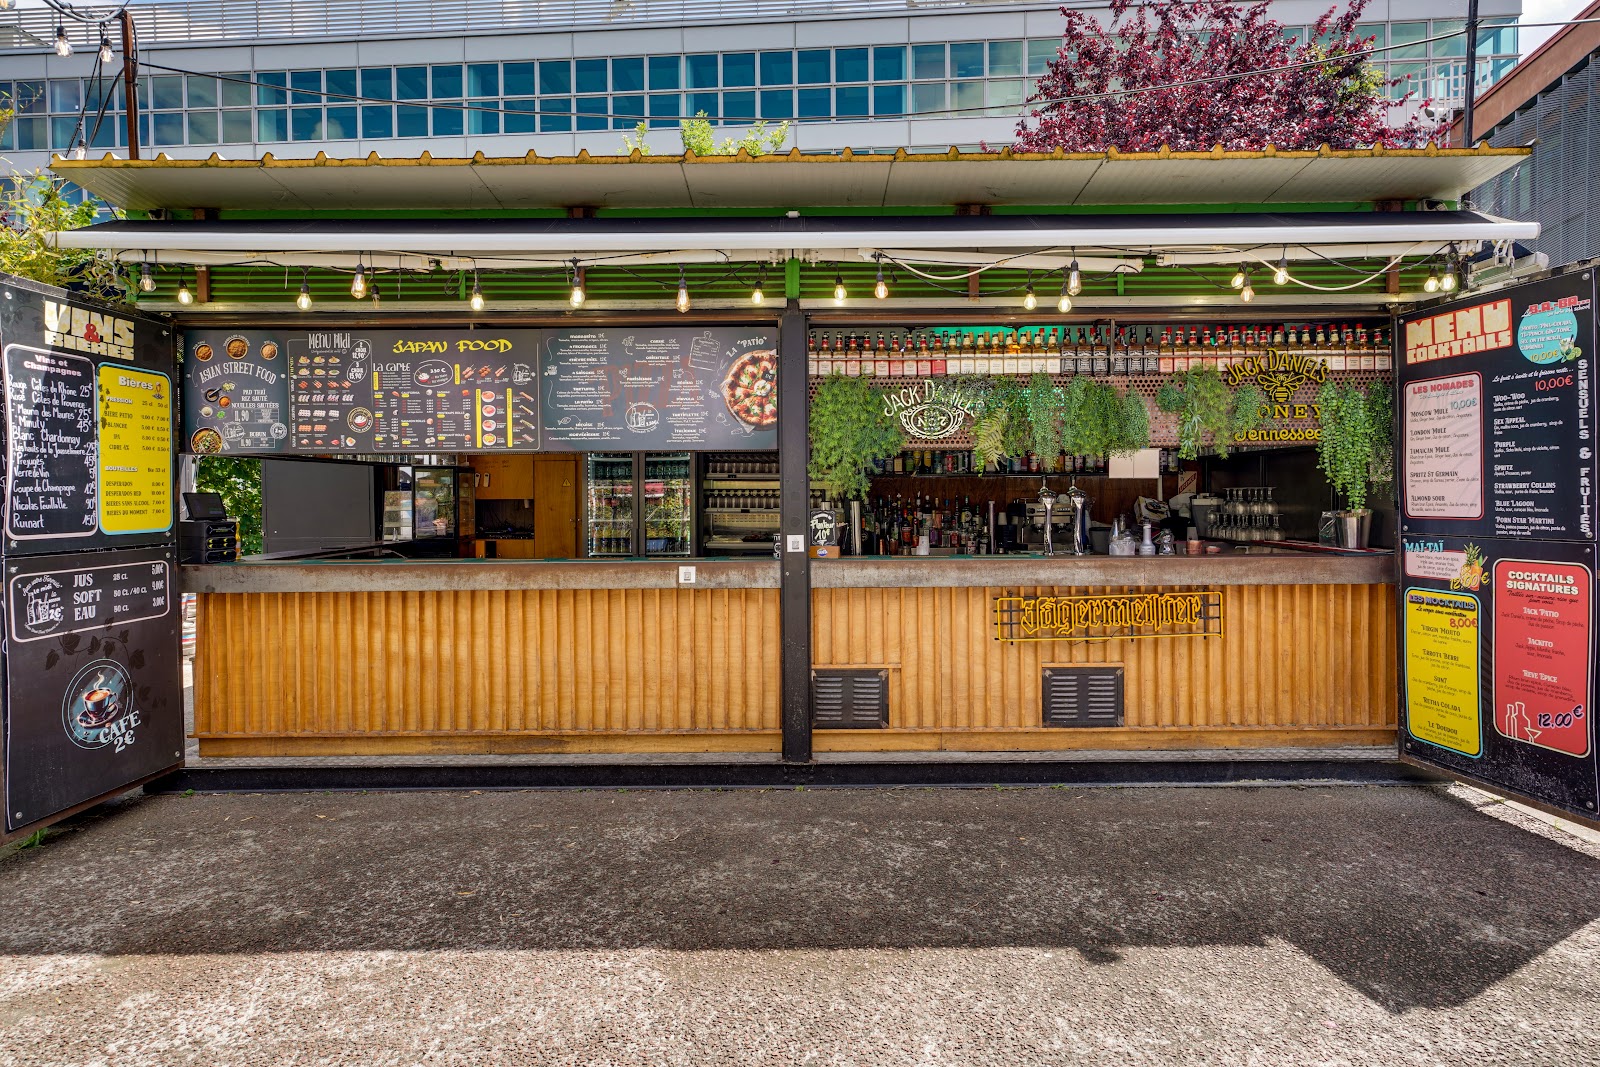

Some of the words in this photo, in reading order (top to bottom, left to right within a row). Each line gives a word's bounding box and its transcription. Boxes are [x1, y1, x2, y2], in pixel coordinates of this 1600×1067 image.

[45, 300, 135, 348] VINS
[1406, 300, 1511, 350] MENU
[84, 323, 101, 343] &
[392, 339, 448, 353] JAPAN
[455, 338, 513, 353] FOOD
[1407, 330, 1511, 364] COCKTAILS
[35, 354, 56, 365] Vins
[373, 362, 384, 372] La
[1225, 354, 1265, 386] JACK
[1267, 347, 1331, 383] DANIEL'S
[23, 360, 82, 376] Champagnes
[199, 363, 222, 384] ASIAN
[223, 361, 254, 375] STREET
[255, 365, 277, 385] FOOD
[58, 381, 77, 396] Rhône
[118, 375, 154, 390] Bières
[1412, 385, 1429, 395] LES
[1430, 379, 1474, 392] NOMADES
[1535, 375, 1574, 391] 10,00€
[61, 394, 86, 409] Provence
[106, 396, 134, 405] PRESSION
[256, 401, 280, 409] SAUTÉES
[882, 386, 921, 417] JACK
[1450, 397, 1478, 410] 10,00€
[1578, 359, 1590, 440] SENSUELS
[1410, 410, 1432, 418] MOSCOW
[12, 425, 35, 440] Blanc
[41, 429, 81, 449] Chardonnay
[1579, 447, 1592, 460] &
[14, 465, 32, 478] Verre
[39, 465, 50, 478] Vin
[13, 480, 34, 496] Coupe
[35, 479, 42, 492] de
[42, 479, 77, 496] Champagne
[13, 496, 39, 511] Nicolas
[13, 513, 44, 528] Ruinart
[810, 519, 836, 530] Planteur
[1512, 516, 1527, 524] STAR
[1405, 540, 1444, 552] MAÏ-TAÏ
[73, 573, 94, 588] JUS
[1508, 571, 1575, 584] COCKTAILS
[1506, 581, 1579, 595] SIGNATURES
[73, 589, 102, 605] SOFT
[1409, 594, 1425, 604] LES
[1425, 596, 1476, 611] MOCKTAILS
[74, 605, 97, 621] EAU
[1021, 594, 1201, 635] Jägermeister
[1523, 607, 1538, 615] JACK
[1539, 609, 1559, 618] PATIO
[1421, 625, 1439, 633] VIRGIN
[1449, 617, 1478, 629] 8,00€
[1436, 723, 1458, 735] DOUDOU
[114, 730, 136, 754] 2€
